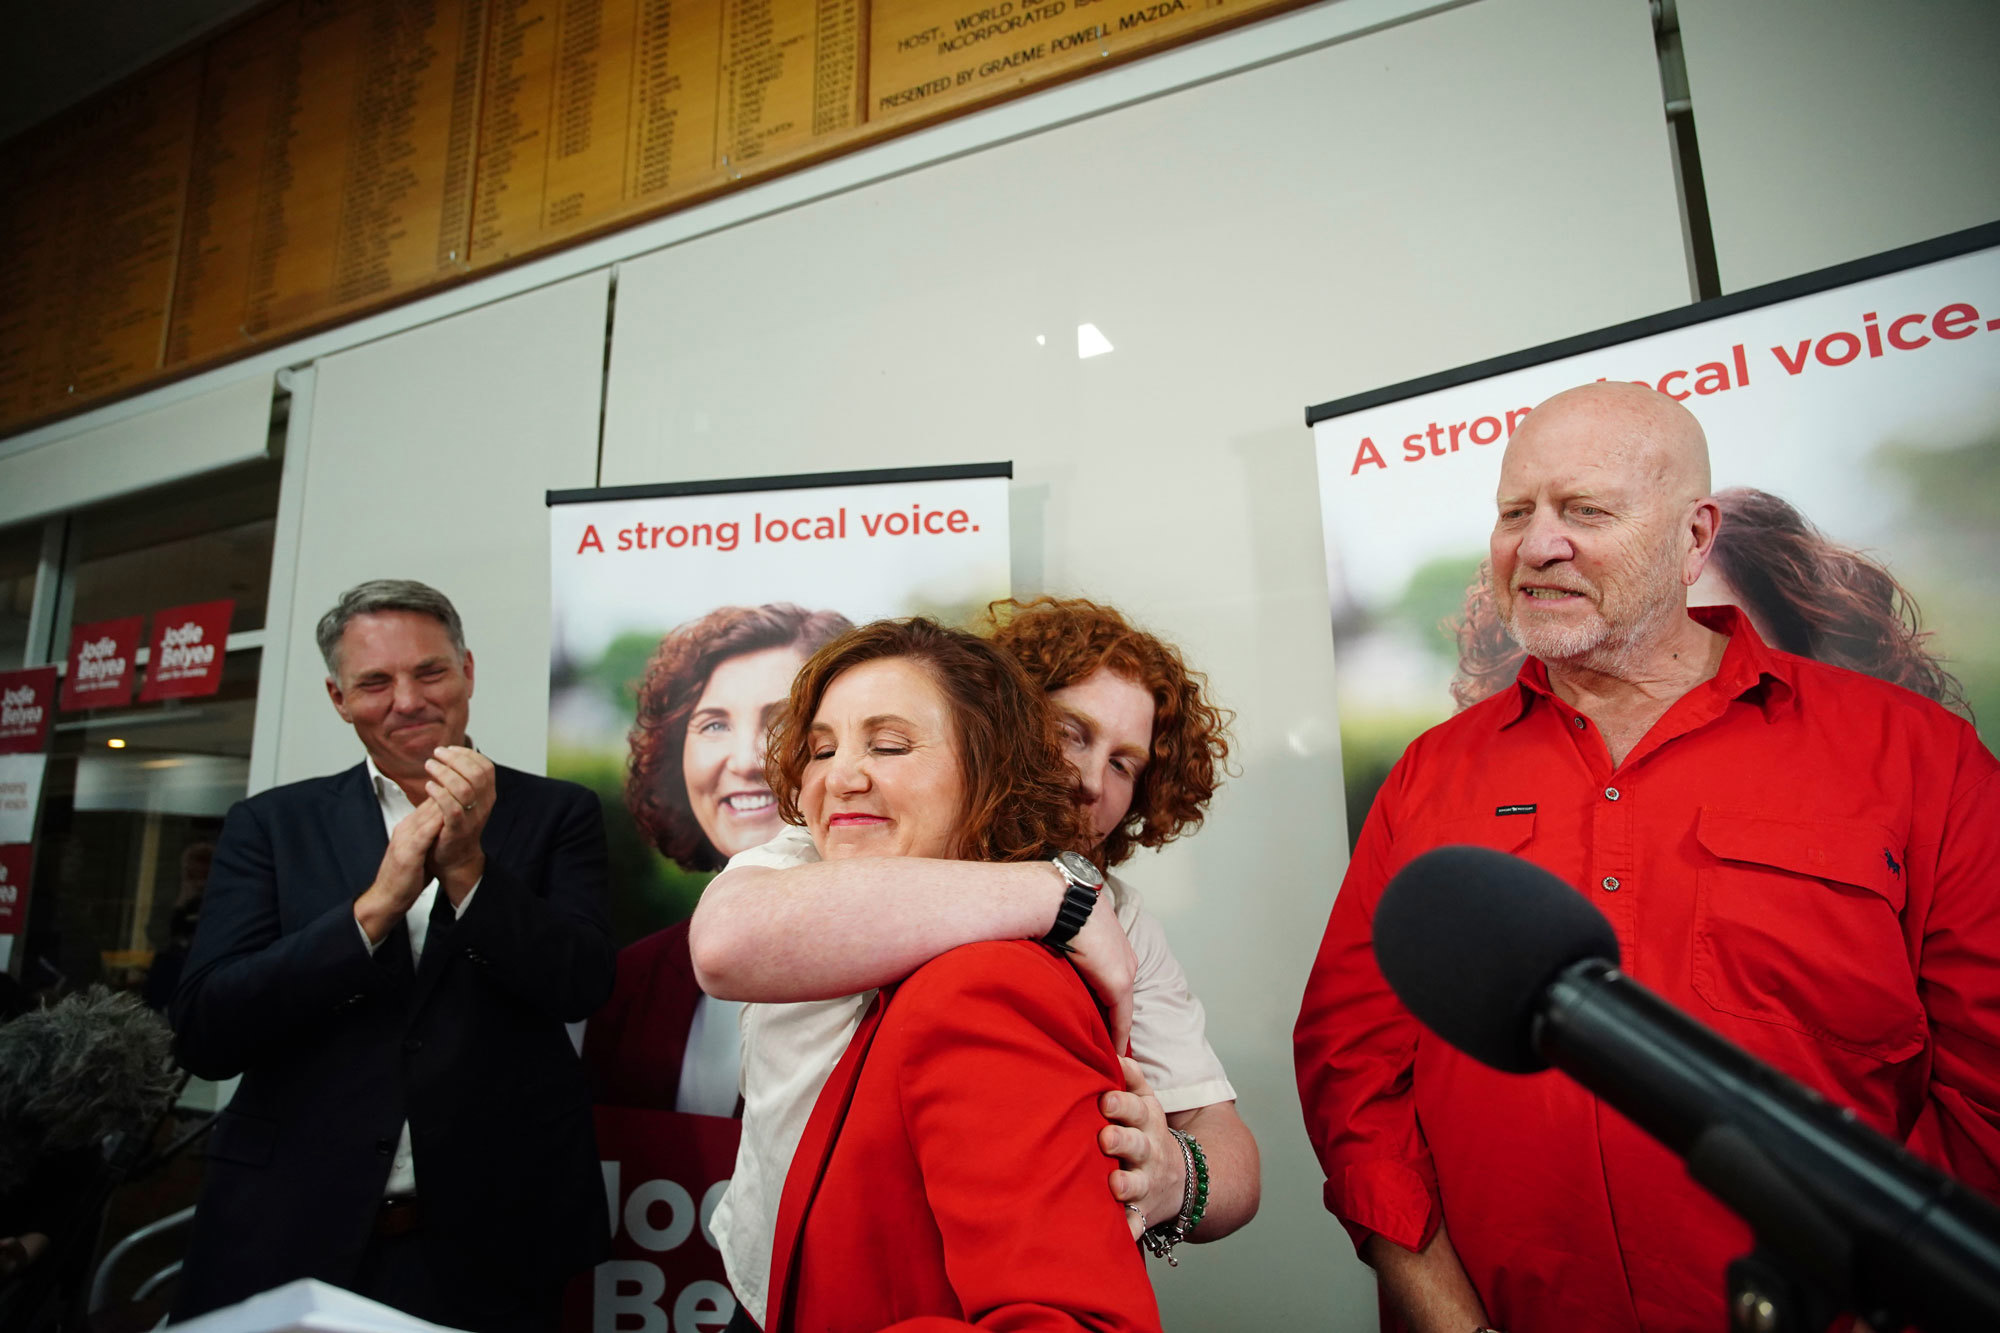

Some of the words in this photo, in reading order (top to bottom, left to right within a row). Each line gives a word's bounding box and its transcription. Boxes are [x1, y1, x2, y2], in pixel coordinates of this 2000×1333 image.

[938, 1, 1066, 55] INCORPORATED
[955, 2, 1014, 32] WORLD
[879, 75, 952, 110] PRESENTED
[956, 67, 976, 86] BY
[979, 43, 1048, 78] GRAEME
[1050, 23, 1112, 54] POWELL
[1350, 437, 1388, 476] A
[1402, 405, 1534, 463] stron
[577, 524, 605, 555] A
[616, 520, 740, 552] strong
[754, 507, 847, 543] local
[860, 504, 981, 537] voice.
[78, 637, 118, 660] Jodie
[160, 622, 204, 648] Jodie
